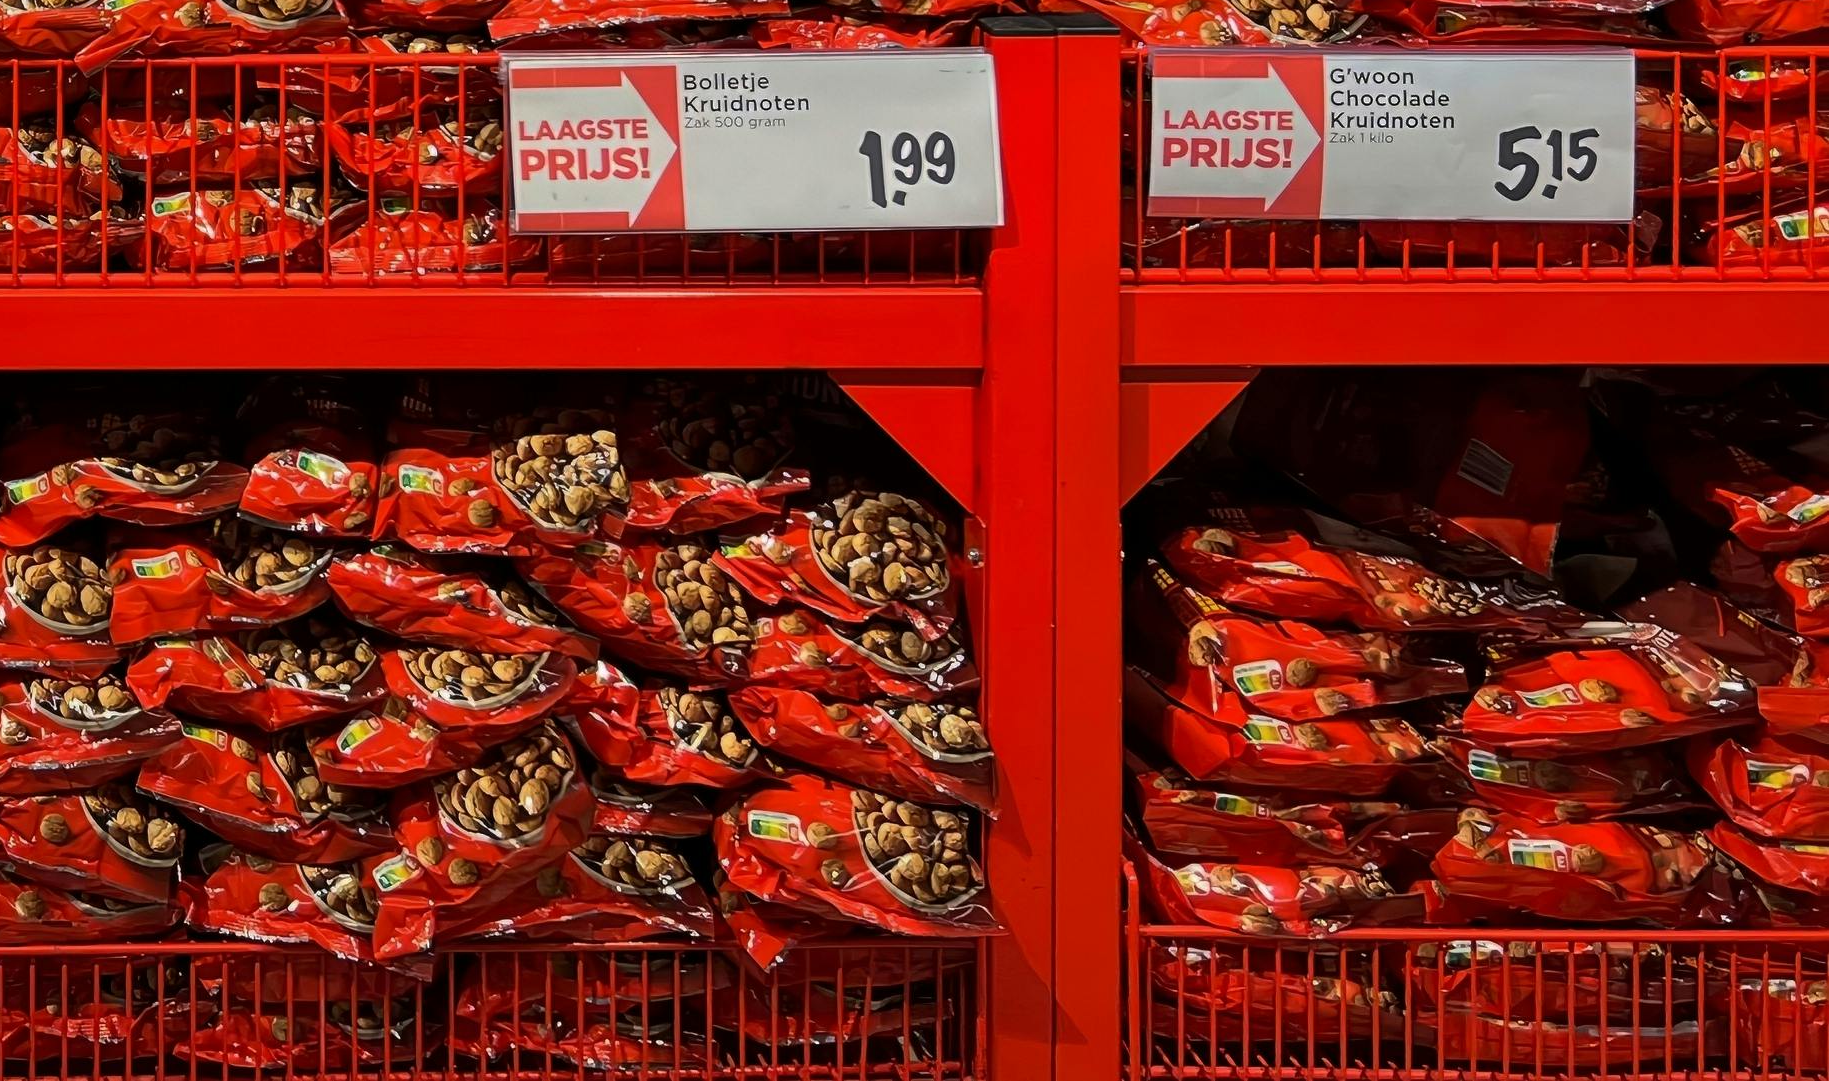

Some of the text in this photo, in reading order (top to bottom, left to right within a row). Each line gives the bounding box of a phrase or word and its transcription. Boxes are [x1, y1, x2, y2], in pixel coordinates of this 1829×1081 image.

[683, 73, 770, 93] Bolletje
[1329, 68, 1414, 85] G'woon
[683, 94, 810, 114] Kruidnoten
[1329, 89, 1450, 107] Chocolade
[518, 118, 648, 141] LAAGSTE
[684, 117, 786, 130] Zak 500 gram
[1163, 110, 1293, 131] LAAGSTE
[1329, 111, 1455, 130] Kruidnoten
[1329, 132, 1394, 144] Zak 1 kilo
[1162, 137, 1292, 169] PRIJS!
[520, 145, 651, 182] PRIJS!
